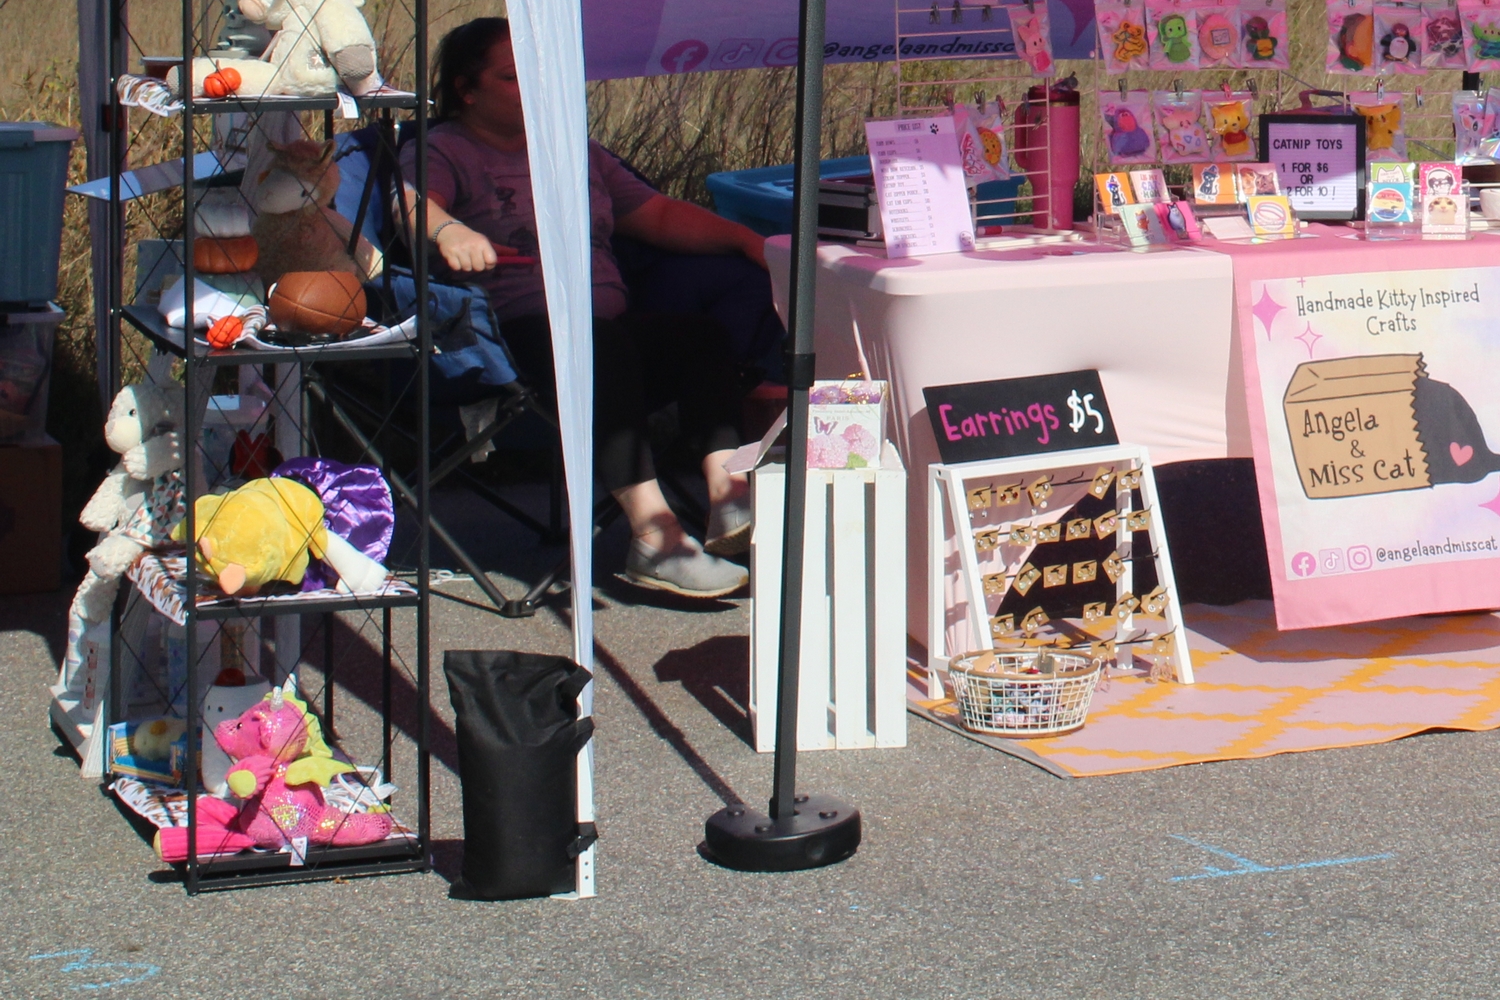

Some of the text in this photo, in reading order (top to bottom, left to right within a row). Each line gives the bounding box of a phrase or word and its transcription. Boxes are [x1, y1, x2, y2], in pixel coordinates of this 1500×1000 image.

[1273, 139, 1343, 150] CATNIP TOYS
[1281, 162, 1329, 173] 1 FOR $6
[1300, 174, 1314, 185] OR
[1286, 186, 1292, 197] 2
[1295, 186, 1313, 197] FOR
[1317, 186, 1328, 197] 10
[1296, 283, 1480, 317] Handmade Kitty Inspired
[1366, 311, 1417, 336] Crafts
[938, 389, 1104, 445] Earrings $5
[1302, 407, 1379, 441] Angela
[1350, 439, 1366, 458] &
[1309, 448, 1416, 488] Miss Cat
[1376, 535, 1498, 562] @angelaandmisscat
